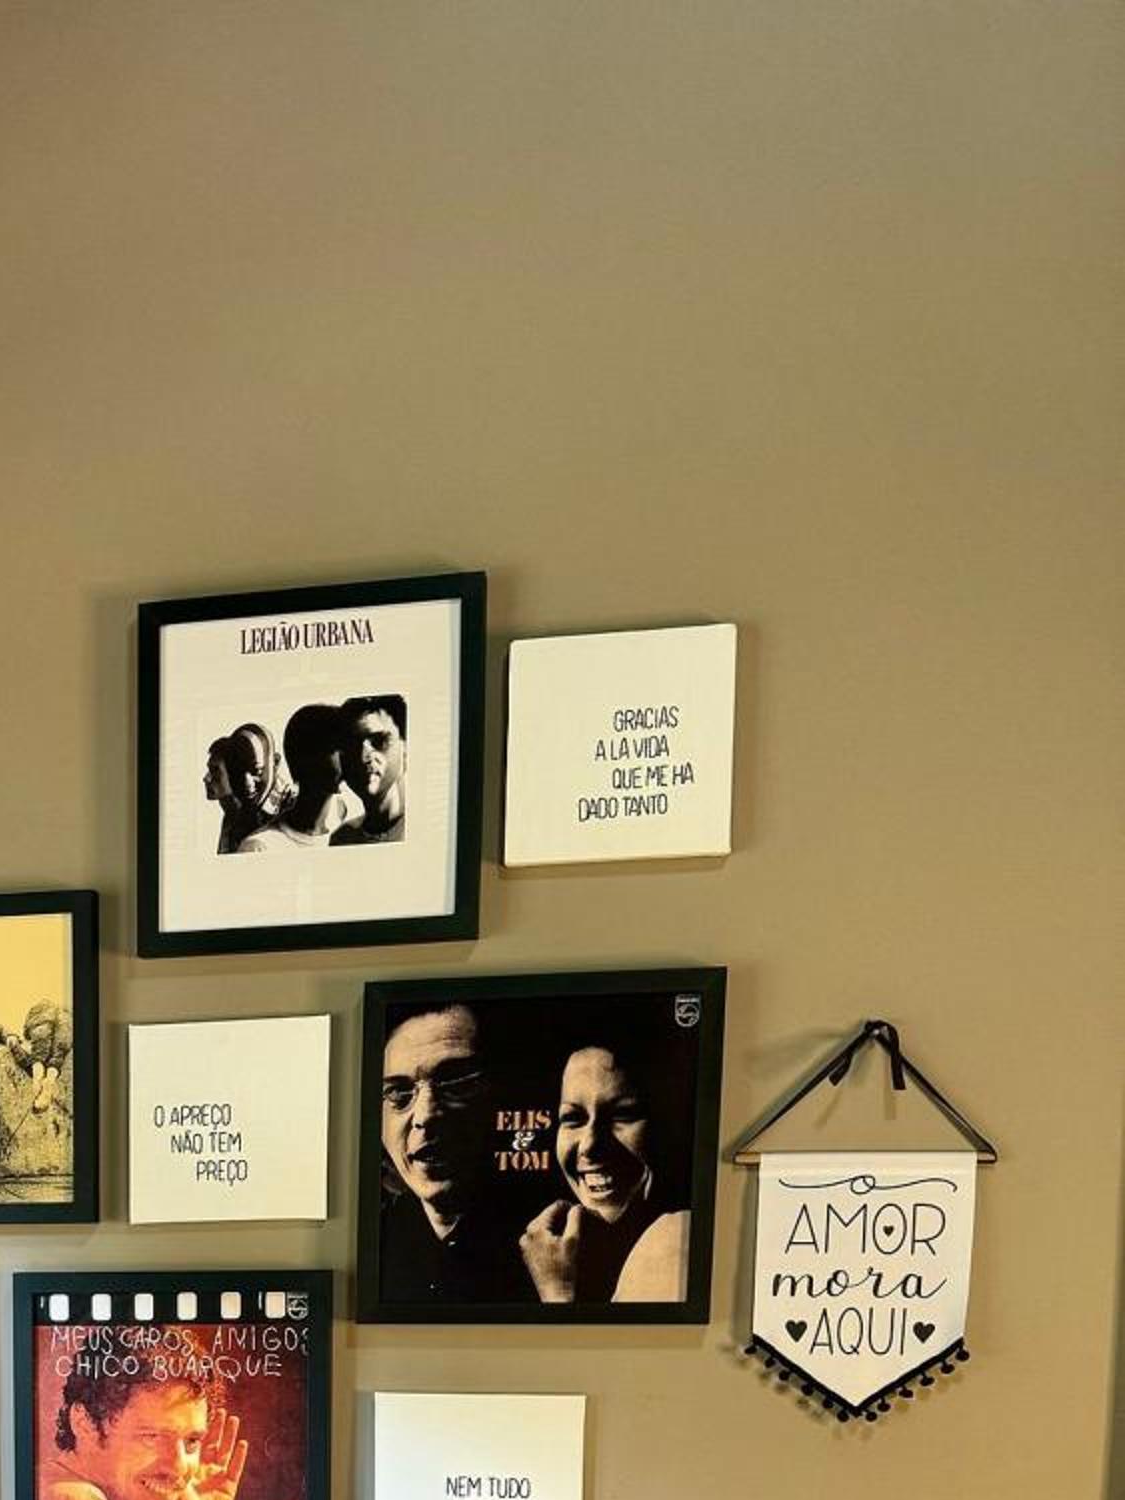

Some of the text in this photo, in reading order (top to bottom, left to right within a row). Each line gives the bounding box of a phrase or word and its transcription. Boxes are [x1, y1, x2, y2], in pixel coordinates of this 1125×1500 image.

[241, 619, 375, 654] LEGIÃO URBANA
[613, 706, 679, 732] GRACIAS
[595, 735, 670, 761] A LA VIDA
[612, 762, 695, 789] QUE ME HA
[578, 793, 668, 822] DADO TANTO
[154, 1103, 232, 1130] O APREÇO
[496, 1110, 551, 1131] ELIS
[170, 1130, 243, 1154] NÃO TEM
[512, 1131, 535, 1150] &
[195, 1159, 249, 1187] PREÇO
[494, 1150, 550, 1172] TOM
[785, 1203, 947, 1256] AMOR
[772, 1266, 948, 1299] mora
[50, 1326, 114, 1355] MEUS
[118, 1326, 195, 1357] CAROS
[809, 1307, 908, 1356] AQUI
[55, 1353, 283, 1383] CHICO BUARQUE
[446, 1476, 531, 1500] NEM TUDO
